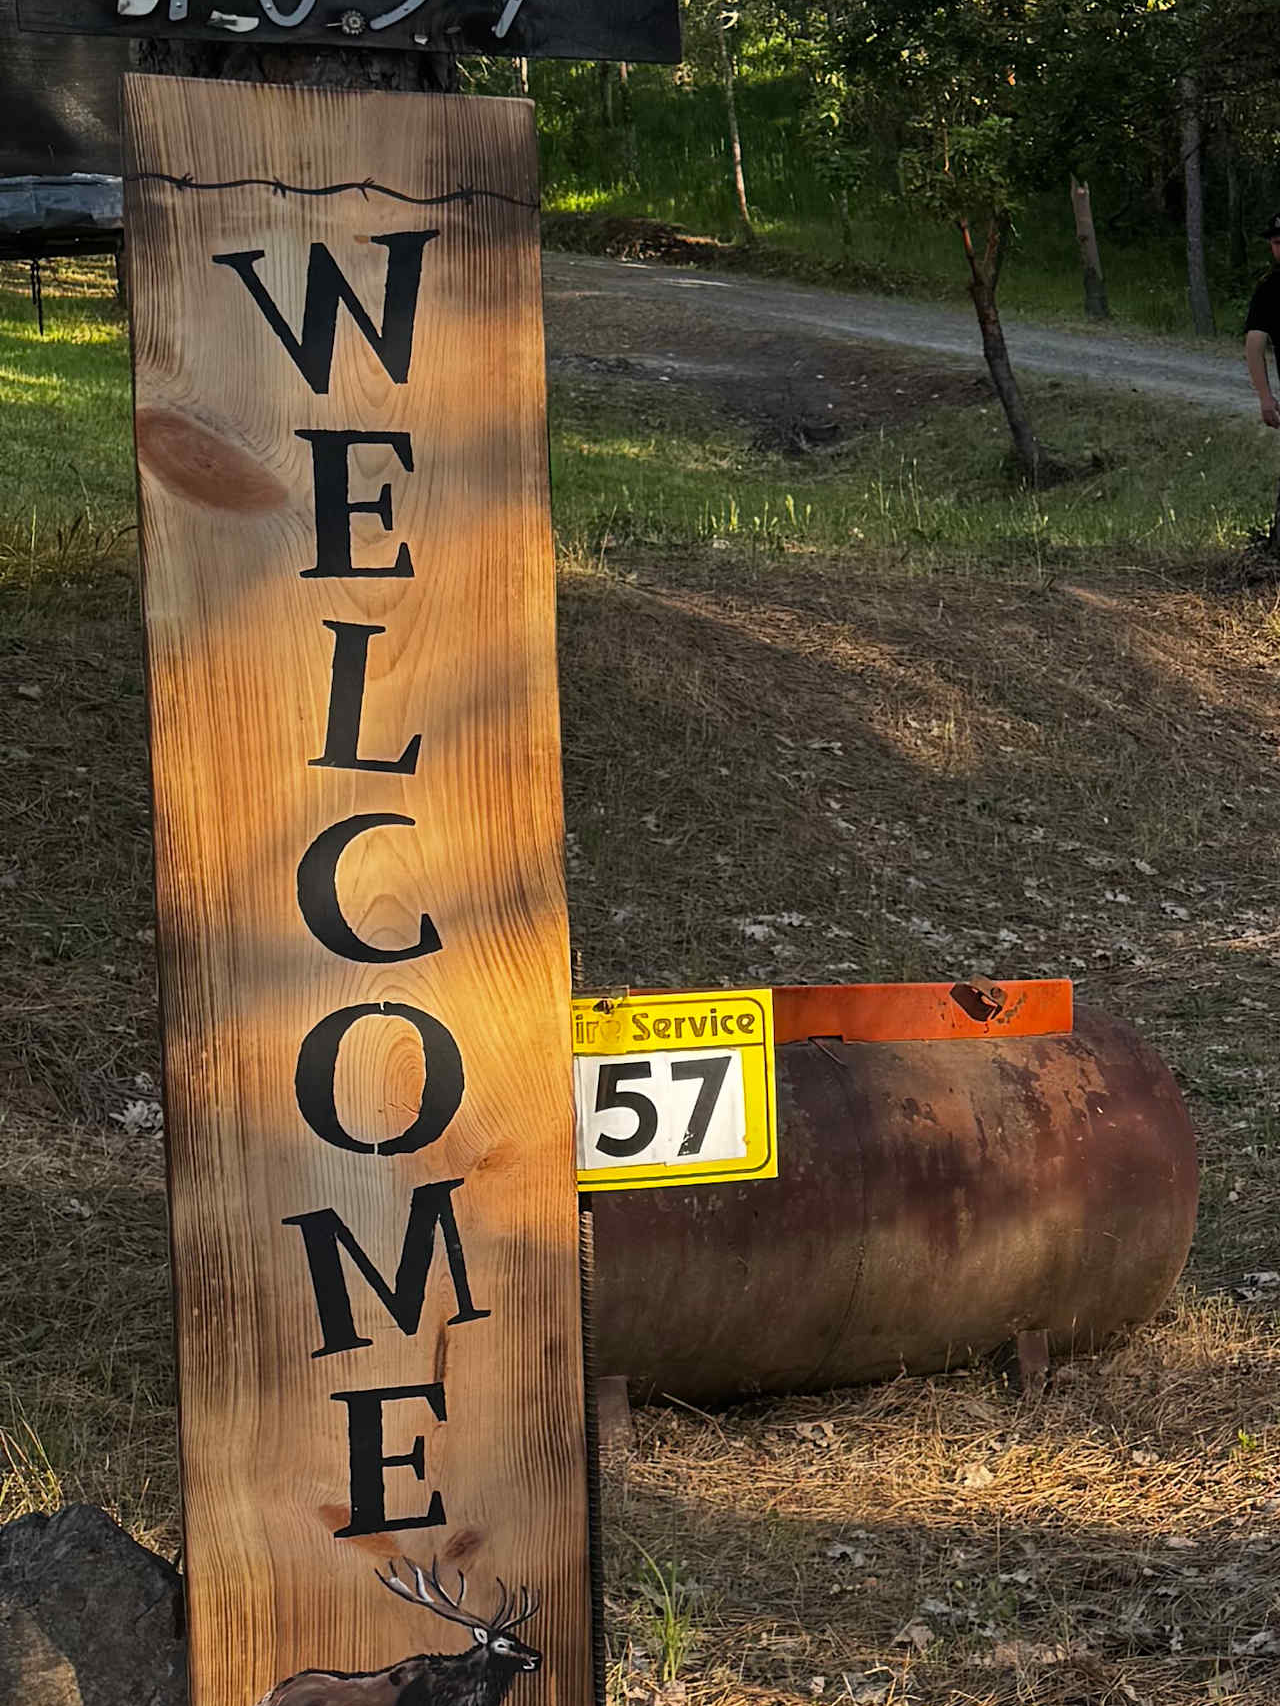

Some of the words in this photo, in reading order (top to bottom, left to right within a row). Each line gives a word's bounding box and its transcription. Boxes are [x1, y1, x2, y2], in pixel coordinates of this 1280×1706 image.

[212, 229, 490, 1538] WELCOME
[574, 1014, 622, 1044] ire
[632, 1008, 755, 1042] Service
